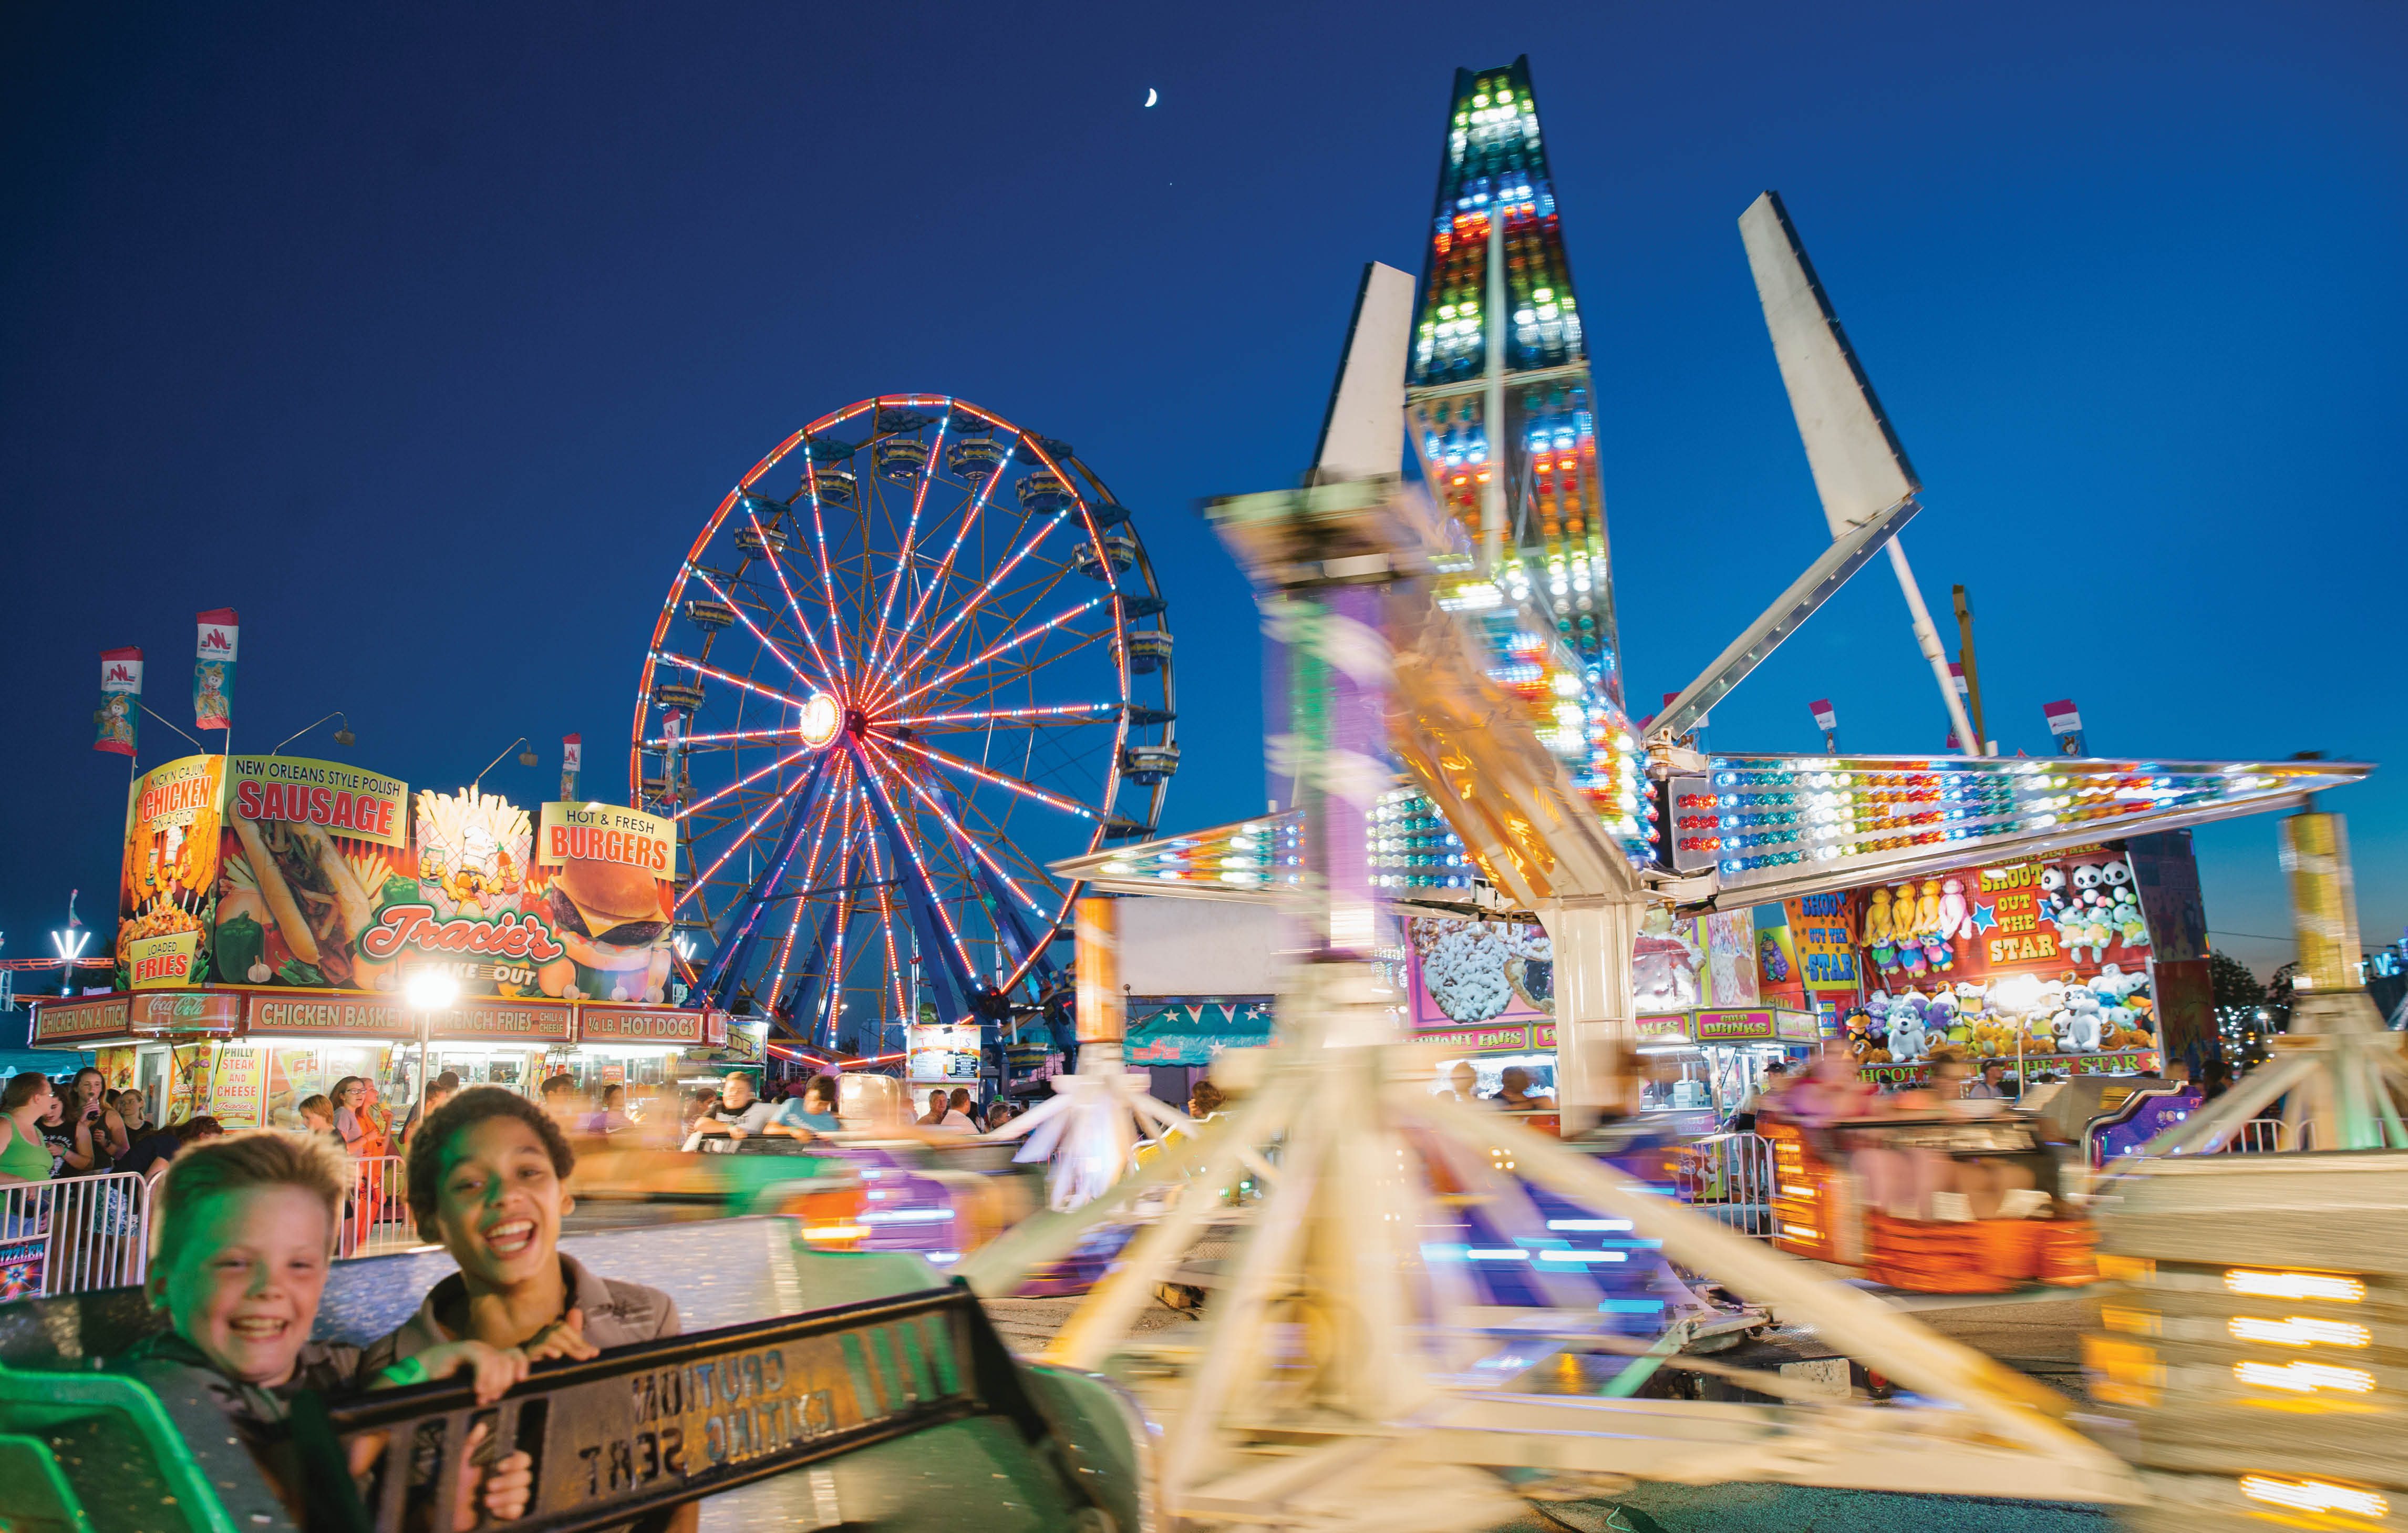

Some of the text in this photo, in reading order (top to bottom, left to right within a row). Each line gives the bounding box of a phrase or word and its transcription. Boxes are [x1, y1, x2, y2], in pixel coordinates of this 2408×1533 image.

[151, 763, 206, 787] KICK'N CAJUN
[236, 759, 400, 797] NEW ORLEANS STYLE POLISH
[142, 776, 212, 822] CHICKEN
[237, 780, 396, 837] SAUSAGE
[151, 811, 195, 831] ON-A-STICK
[567, 810, 655, 835] HOT & FRESH
[550, 825, 669, 872] BURGERS
[1980, 863, 2045, 892] SHOOT
[1998, 893, 2031, 912] OUT
[364, 904, 564, 962] Tracie's
[1999, 913, 2037, 933] THE
[1809, 928, 1848, 944] OUT THE
[148, 942, 177, 955] LOADED
[1990, 934, 2056, 963] STAR
[135, 953, 188, 983] FRIES
[493, 965, 536, 986] OUT
[1808, 953, 1856, 982] STAR
[42, 1003, 128, 1035] CHICKEN ON A STICK
[261, 1003, 405, 1027] CHICKEN BASKET
[443, 1009, 533, 1032] RENCH FRIES
[539, 1012, 564, 1022] CHILI &
[602, 1018, 616, 1033] LB.
[620, 1016, 651, 1035] HOT
[656, 1017, 696, 1036] DOGS
[539, 1024, 563, 1033] CHEESE
[1479, 1031, 1523, 1047] EARS
[1703, 1022, 1768, 1034] DRINKS
[224, 1047, 255, 1057] PHILLY
[222, 1058, 255, 1069] STEAK
[1857, 1067, 1917, 1083] HOOT
[2079, 1055, 2142, 1073] STAR
[229, 1074, 246, 1083] AND
[217, 1086, 256, 1097] CHEESE
